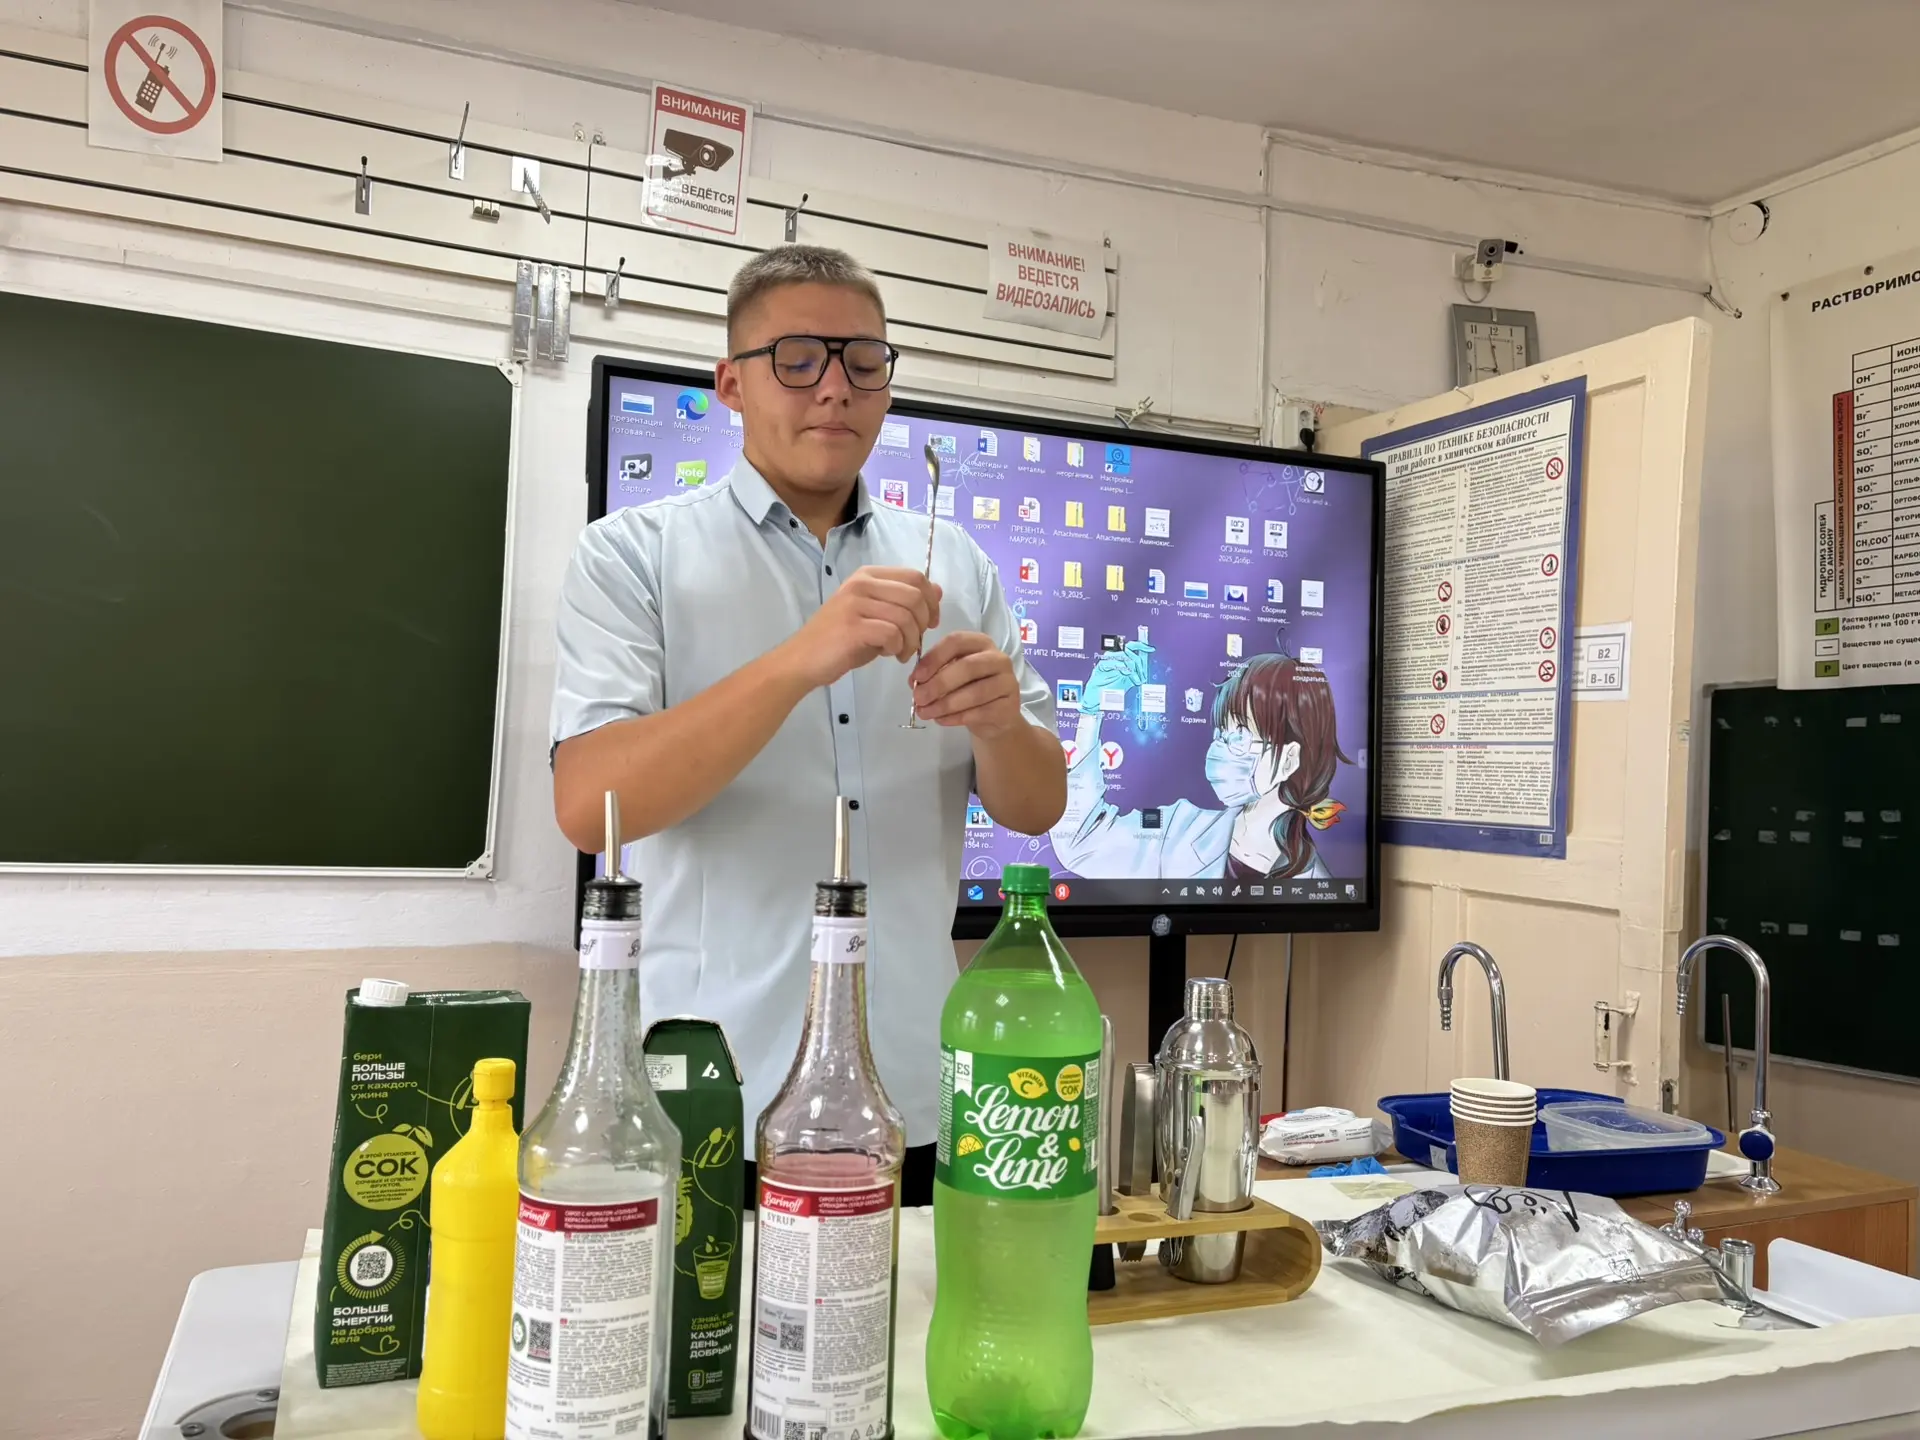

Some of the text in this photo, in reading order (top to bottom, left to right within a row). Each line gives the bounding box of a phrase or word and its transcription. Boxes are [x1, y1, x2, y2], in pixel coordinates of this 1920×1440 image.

[661, 94, 740, 125] ВНИМАНИЕ
[681, 183, 735, 206] ВЕДЁТСЯ
[652, 191, 734, 218] ДЕОНАБЛЮДЕНИЕ
[1008, 242, 1086, 273] ВНИМАНИЕ!
[1018, 264, 1079, 292] ВЕДЕТСЯ
[996, 283, 1096, 319] ВИДЕОЗАПИСЬ
[1489, 326, 1499, 335] 12
[1894, 362, 1920, 374] ГИДРО
[611, 415, 663, 427] презентация
[673, 421, 710, 433] Microsoft
[612, 426, 643, 437] готовая
[682, 434, 702, 444] Edge
[1387, 411, 1550, 465] ПРАВИЛА ПО ТЕХНИКЕ БЕЗОПАСНОСТИ
[1395, 428, 1538, 475] при работе в химическом кабинете
[1894, 457, 1920, 466] НИТРА
[678, 467, 704, 478] Note
[1100, 474, 1135, 484] Настройки
[620, 483, 652, 495] Capture
[1818, 513, 1828, 598] ГИДРОЛИЗ СОЛЕЙ
[1111, 594, 1119, 602] 10
[1176, 600, 1215, 610] презентация
[1261, 606, 1287, 614] Сборник
[1181, 715, 1206, 724] Корзина
[974, 831, 994, 839] марта
[1291, 887, 1303, 895] РУС
[353, 1052, 382, 1061] бери
[352, 1062, 406, 1073] БОЛЬШЕ
[957, 1062, 970, 1076] ES
[351, 1071, 405, 1082] ПОЛЬЗЫ
[367, 1080, 418, 1090] каждого
[1020, 1080, 1033, 1095] C
[1061, 1084, 1080, 1095] СОК
[350, 1091, 388, 1101] ужина
[964, 1084, 1081, 1139] Lemon
[1037, 1133, 1059, 1158] &
[354, 1157, 420, 1178] СОК
[973, 1137, 1068, 1191] Lime
[767, 1213, 796, 1226] SYRUP
[333, 1304, 389, 1316] БОЛЬШЕ
[332, 1314, 393, 1327] ЭНЕРГИИ
[331, 1324, 396, 1336] на добрые
[691, 1323, 733, 1340] КАЖДЫЙ
[330, 1335, 361, 1346] дела
[690, 1339, 719, 1350] ДЕНЬ
[689, 1344, 732, 1360] ДОБРЫМ
